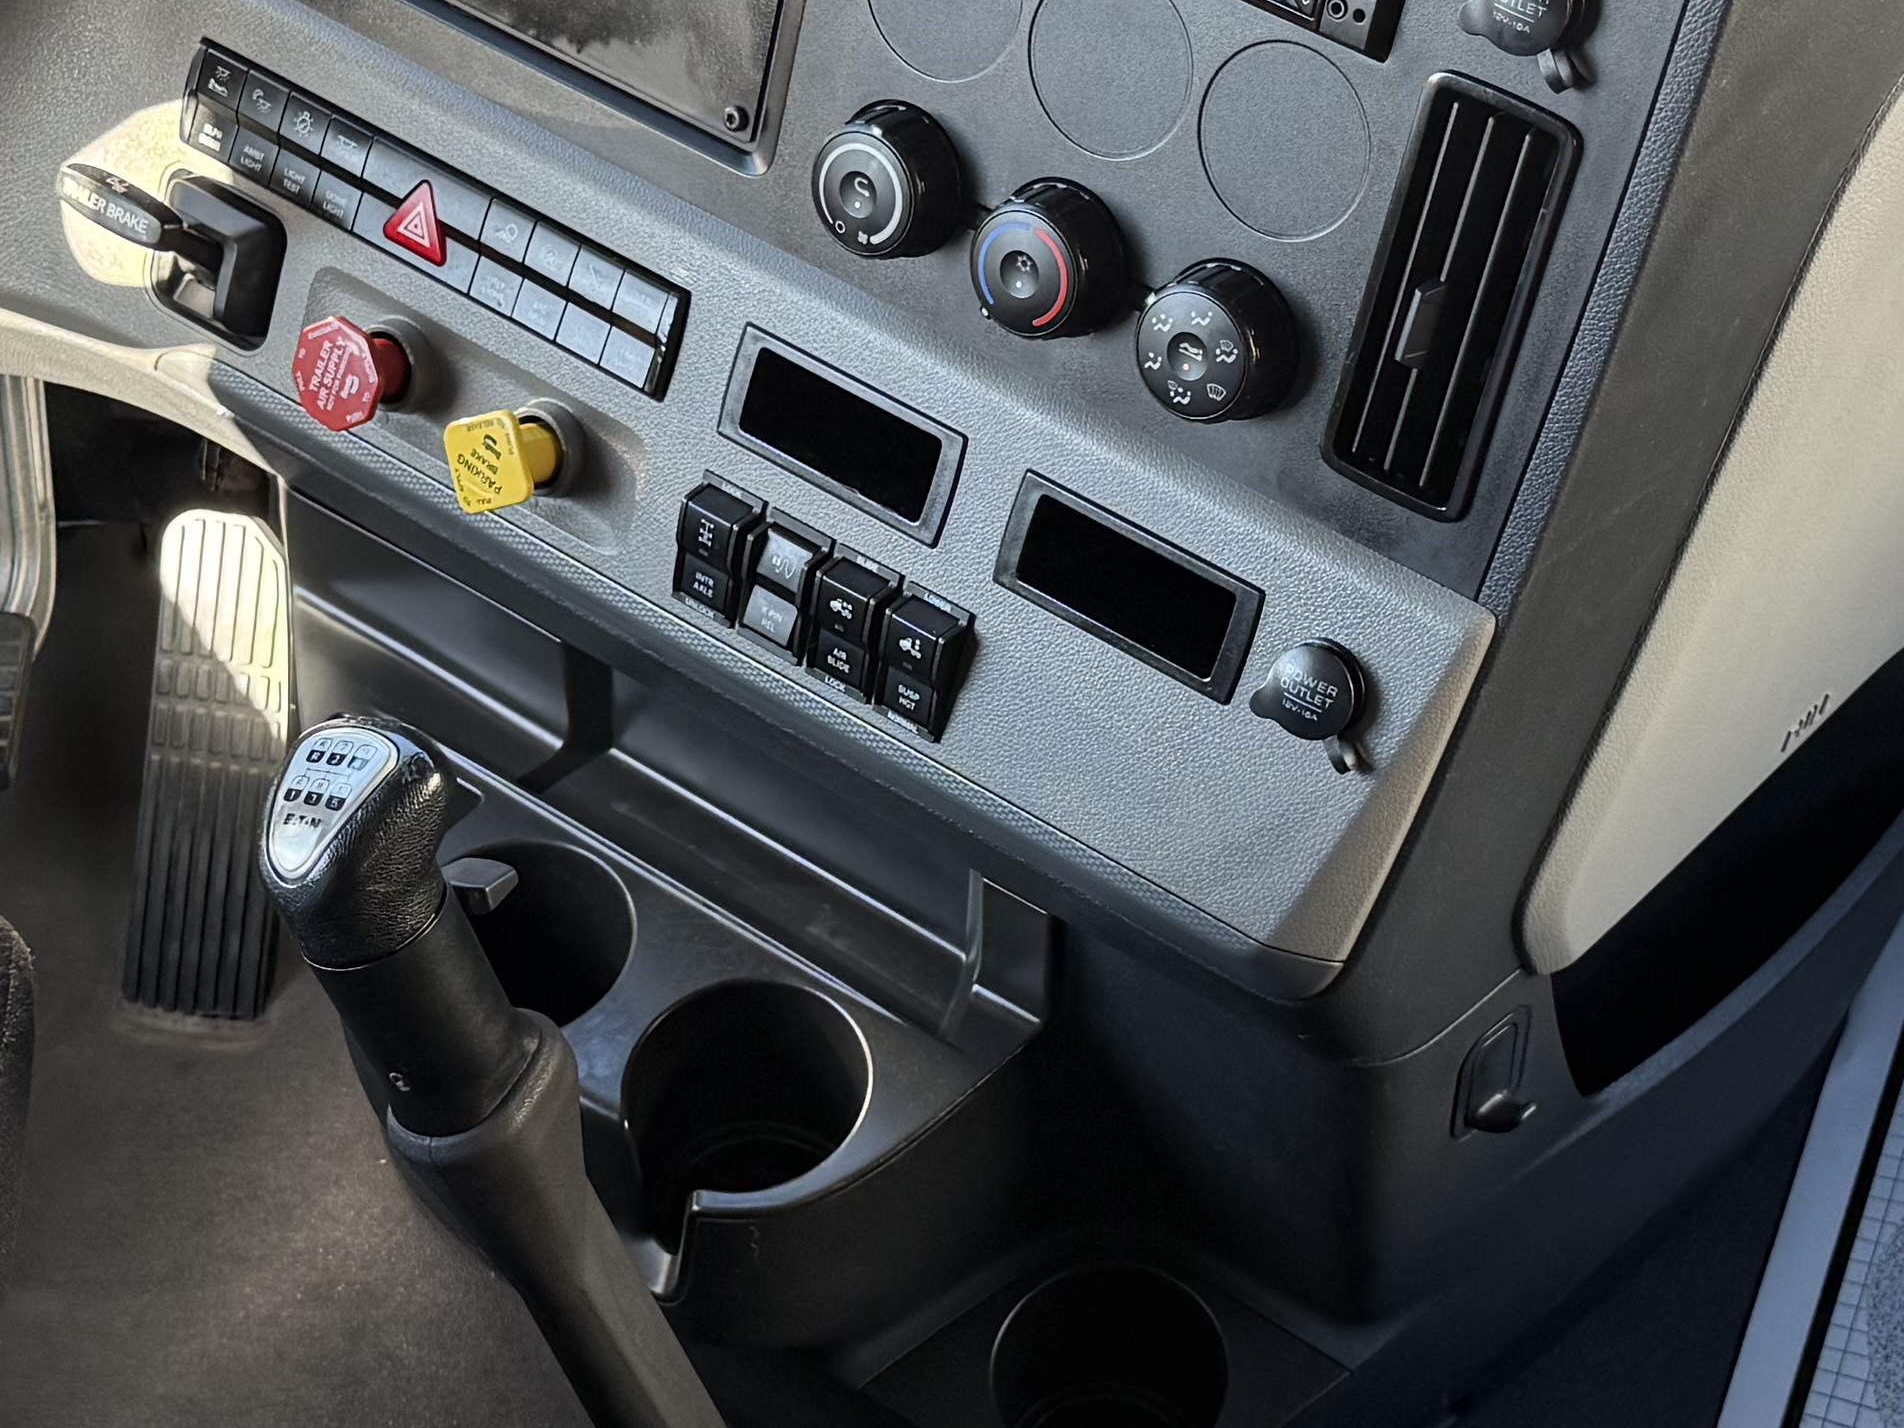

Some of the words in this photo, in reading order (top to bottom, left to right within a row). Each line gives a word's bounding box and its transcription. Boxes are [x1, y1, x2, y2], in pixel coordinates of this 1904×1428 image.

[240, 156, 262, 173] LIGHT
[105, 202, 149, 234] BRAKE
[308, 339, 334, 392] TRAILER
[322, 335, 346, 387] SUPPLY
[316, 387, 329, 411] AIR
[456, 453, 503, 495] PARKING
[470, 448, 499, 476] BRAKE
[833, 647, 847, 661] AIR
[1280, 676, 1334, 709] OUTLET
[1285, 663, 1338, 698] POWER
